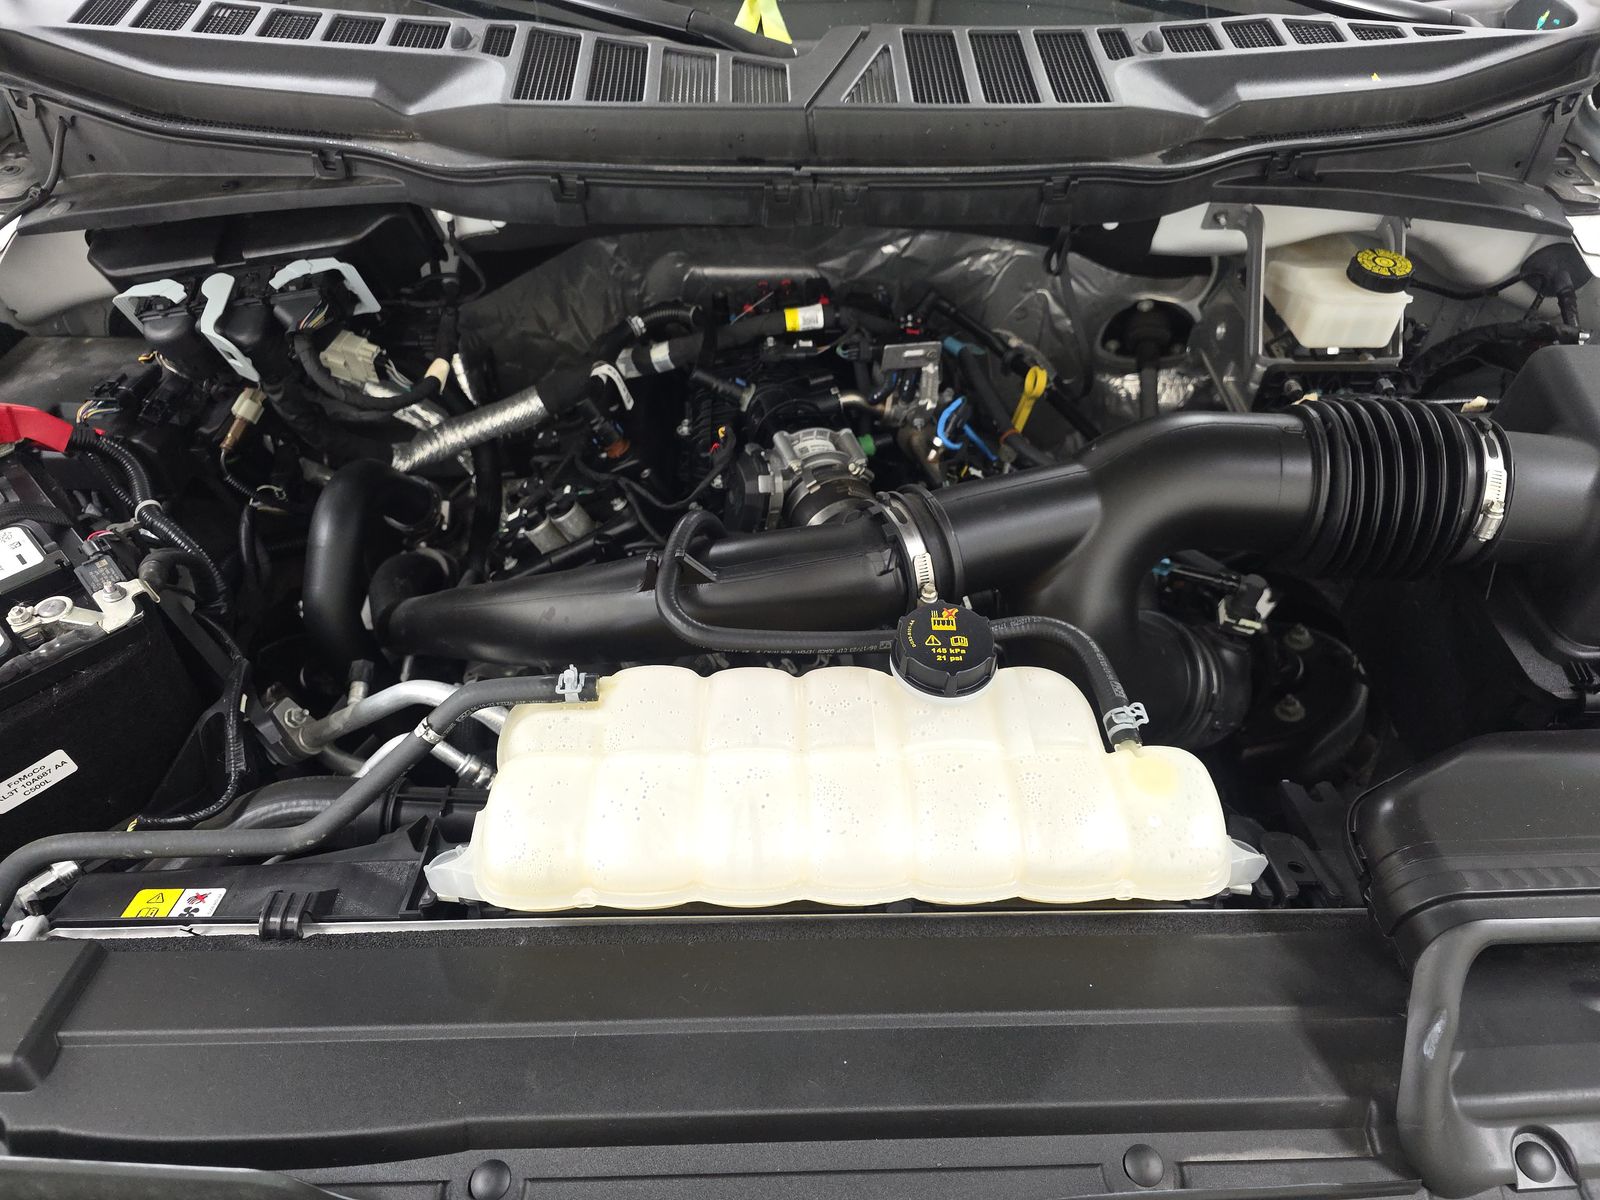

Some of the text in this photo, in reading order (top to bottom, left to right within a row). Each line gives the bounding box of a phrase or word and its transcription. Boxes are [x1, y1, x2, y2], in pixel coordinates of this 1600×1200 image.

[0, 760, 68, 802] L3T 10A687 AA
[7, 765, 46, 788] FoMoCo
[23, 779, 52, 796] C500L
